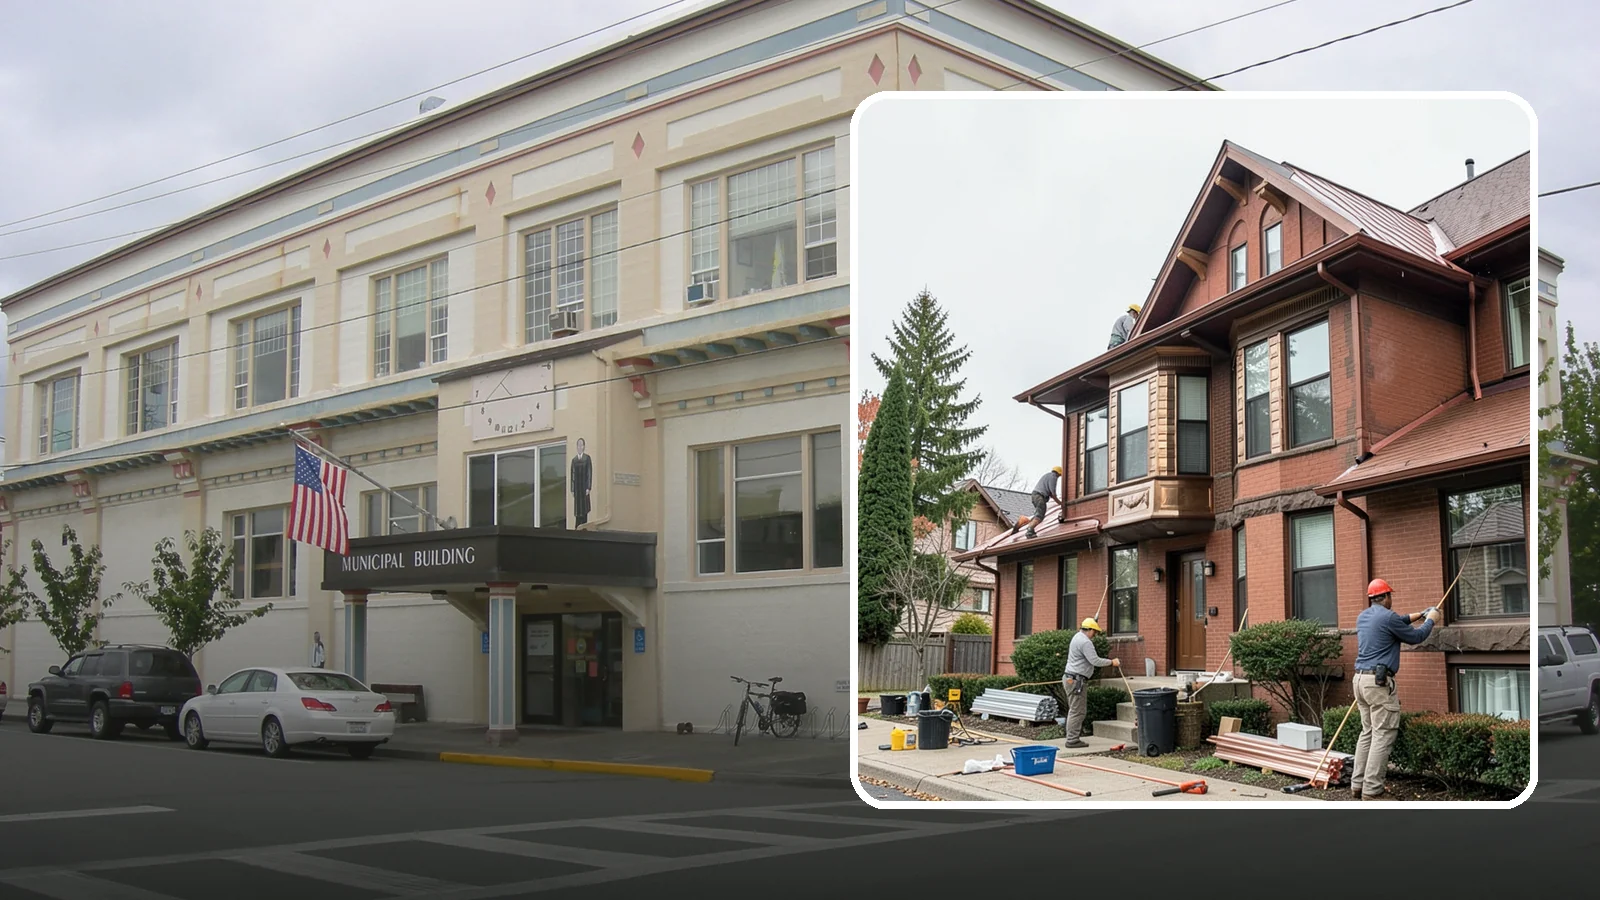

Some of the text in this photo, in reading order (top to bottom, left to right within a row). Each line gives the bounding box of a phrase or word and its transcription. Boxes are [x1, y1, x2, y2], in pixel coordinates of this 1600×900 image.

[480, 407, 485, 415] 8
[488, 418, 493, 426] 9
[494, 423, 500, 432] 10
[507, 425, 514, 433] 12
[521, 420, 526, 428] 2
[529, 414, 533, 422] 3
[536, 402, 540, 410] 4
[342, 546, 475, 571] MUNICIPAL BUILDING
